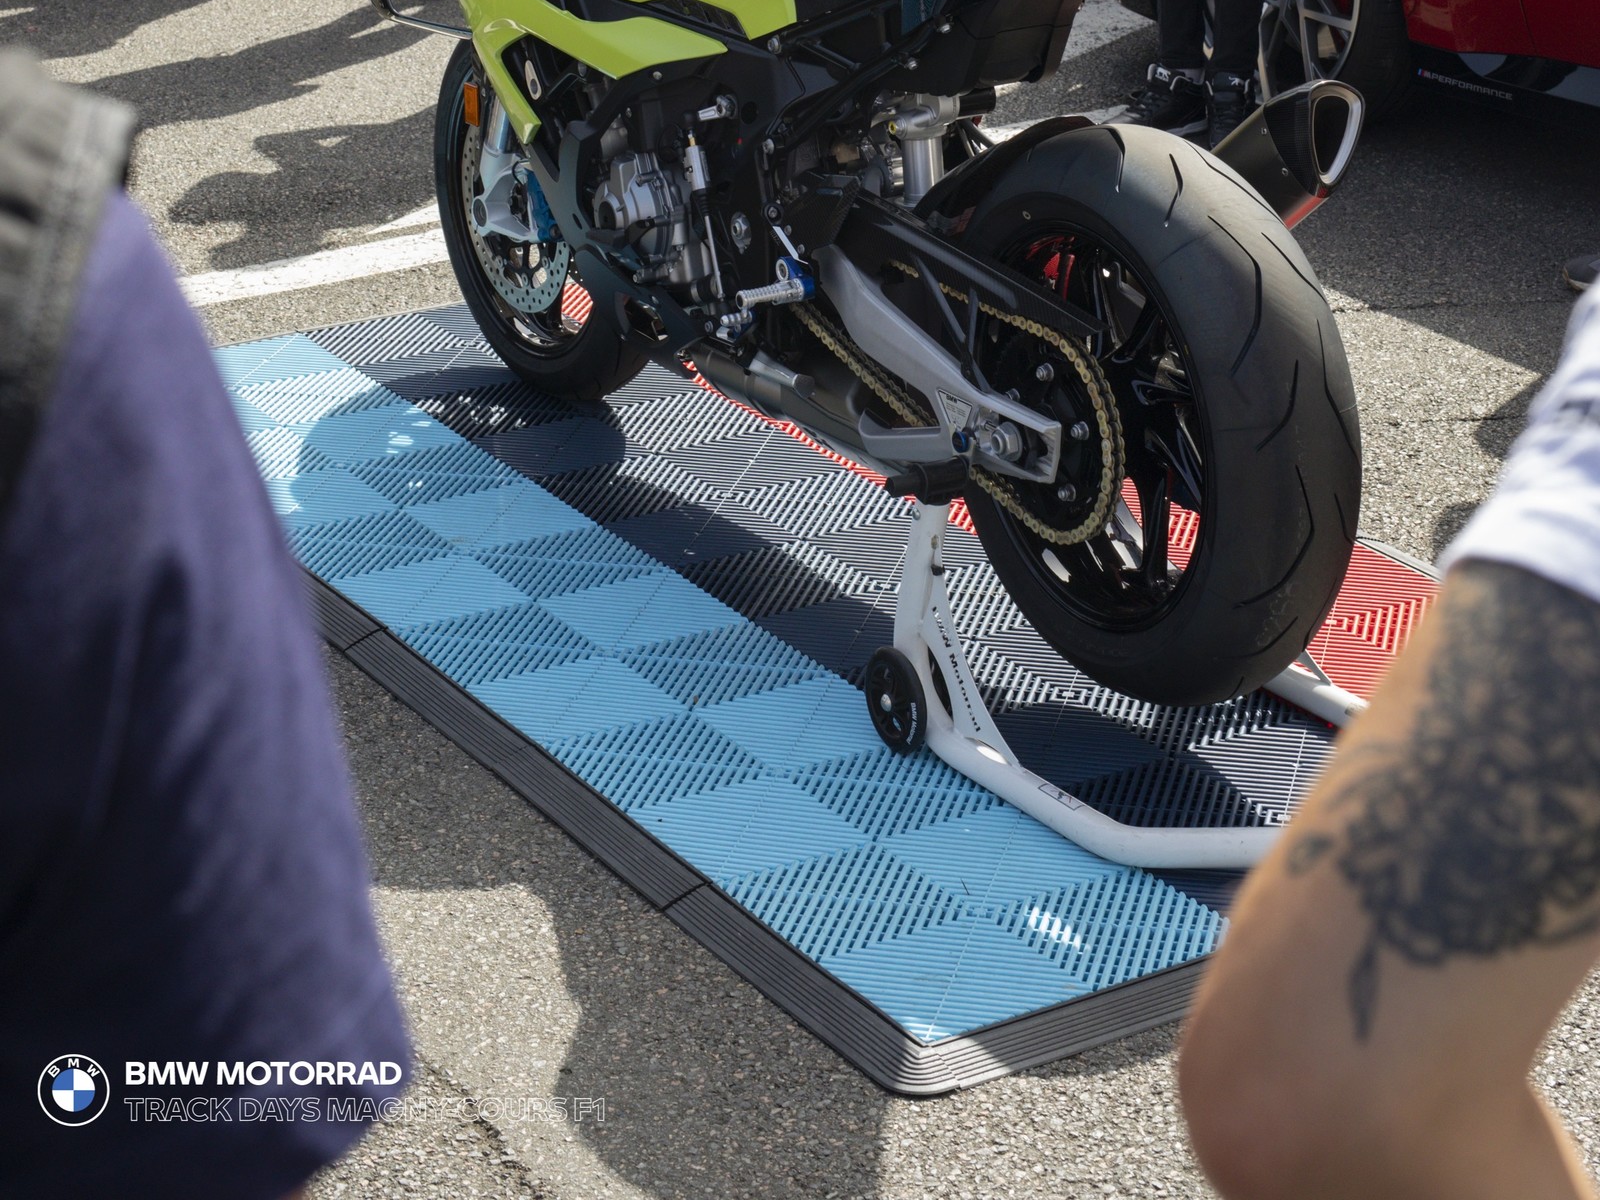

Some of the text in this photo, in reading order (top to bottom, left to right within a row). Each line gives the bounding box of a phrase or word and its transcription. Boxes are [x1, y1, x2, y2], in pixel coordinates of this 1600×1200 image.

[1431, 73, 1514, 101] PERFORMANCE
[949, 653, 981, 732] Motorrad
[910, 702, 918, 722] BMW
